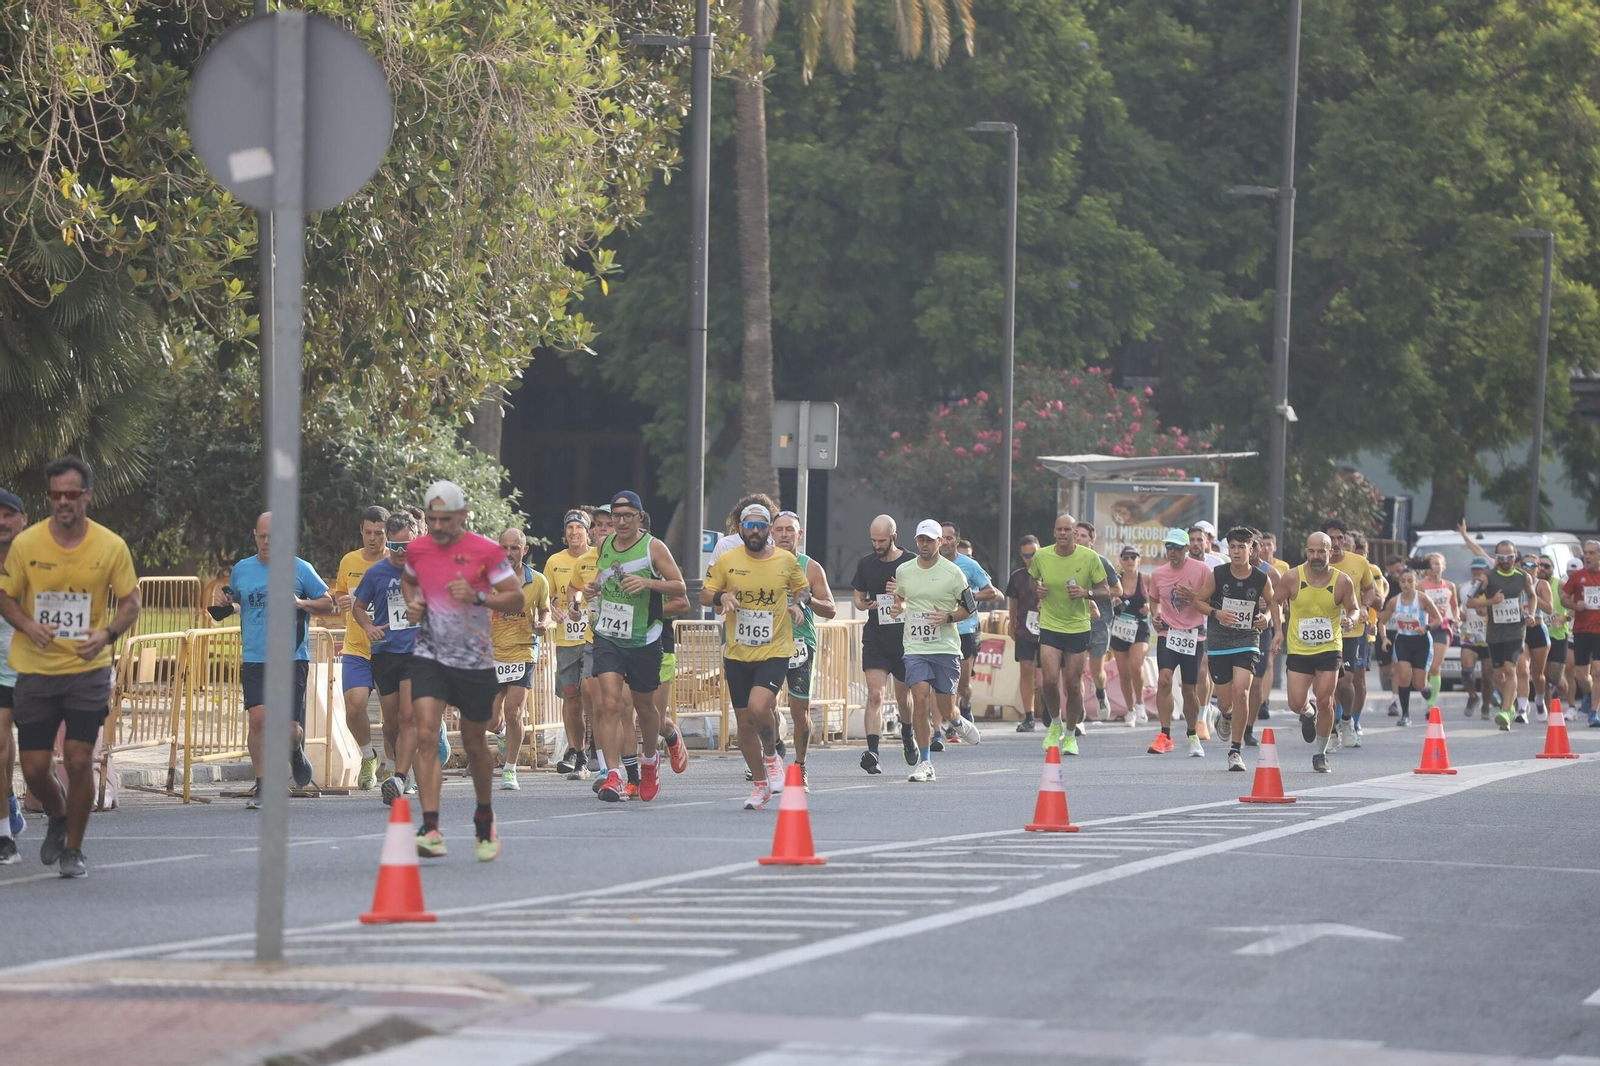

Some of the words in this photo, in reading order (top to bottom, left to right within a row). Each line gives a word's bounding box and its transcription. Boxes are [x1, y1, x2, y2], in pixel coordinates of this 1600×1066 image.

[1104, 525, 1117, 539] TU
[1121, 525, 1178, 541] MICROBIO
[1587, 595, 1600, 604] 78
[393, 609, 408, 623] 14
[879, 605, 892, 616] 10
[39, 610, 84, 627] 8431
[601, 616, 629, 632] 1741
[1469, 620, 1484, 629] 139
[566, 621, 588, 634] 802
[738, 623, 770, 638] 8165
[910, 624, 936, 636] 2187
[1029, 621, 1039, 631] 15
[1302, 628, 1331, 641] 8386
[1169, 636, 1195, 649] 5336
[497, 663, 525, 675] 0826
